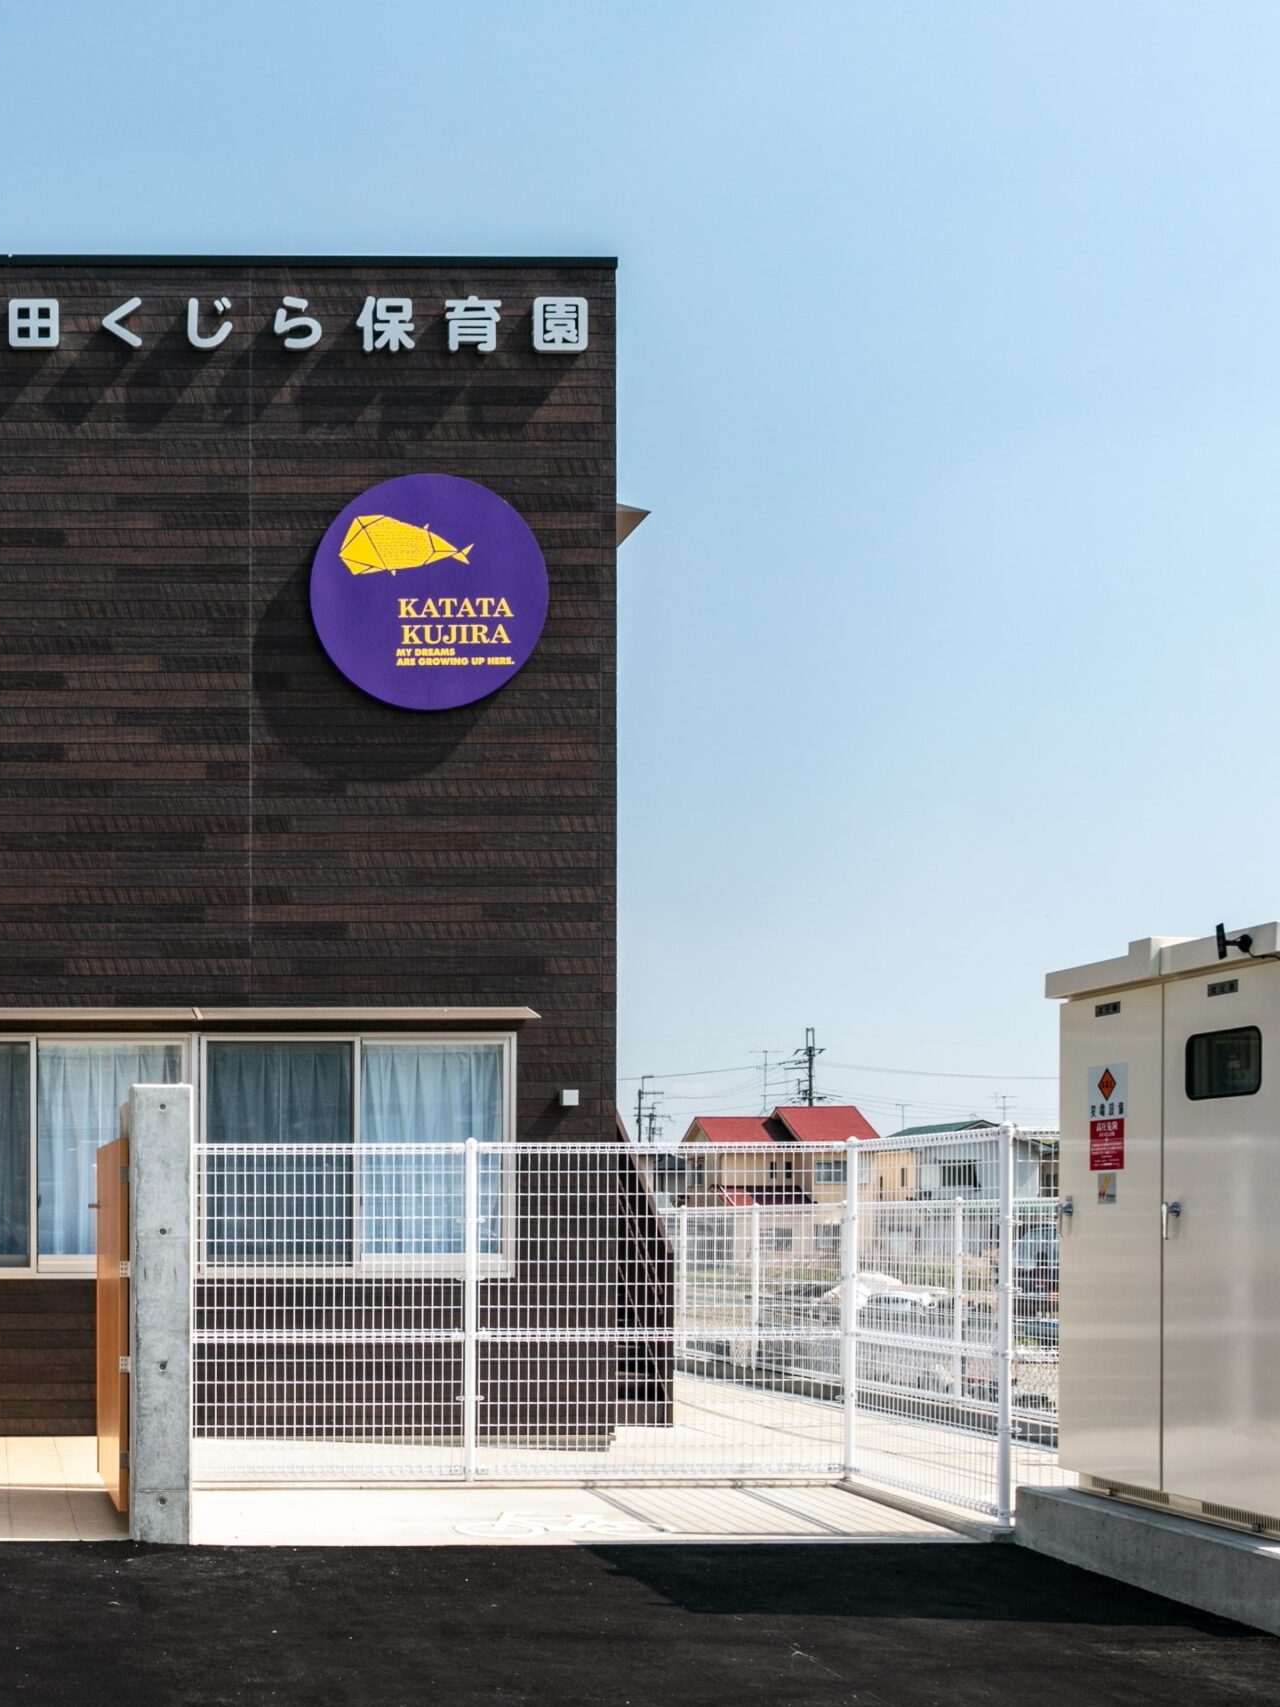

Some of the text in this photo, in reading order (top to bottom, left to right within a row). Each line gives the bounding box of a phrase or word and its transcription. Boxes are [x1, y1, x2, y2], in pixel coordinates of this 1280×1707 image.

[398, 597, 514, 618] KATATA
[401, 624, 511, 645] KUJIRA
[396, 648, 455, 657] MY DREAMS
[396, 656, 515, 666] ARE GROWING UP HERE.
